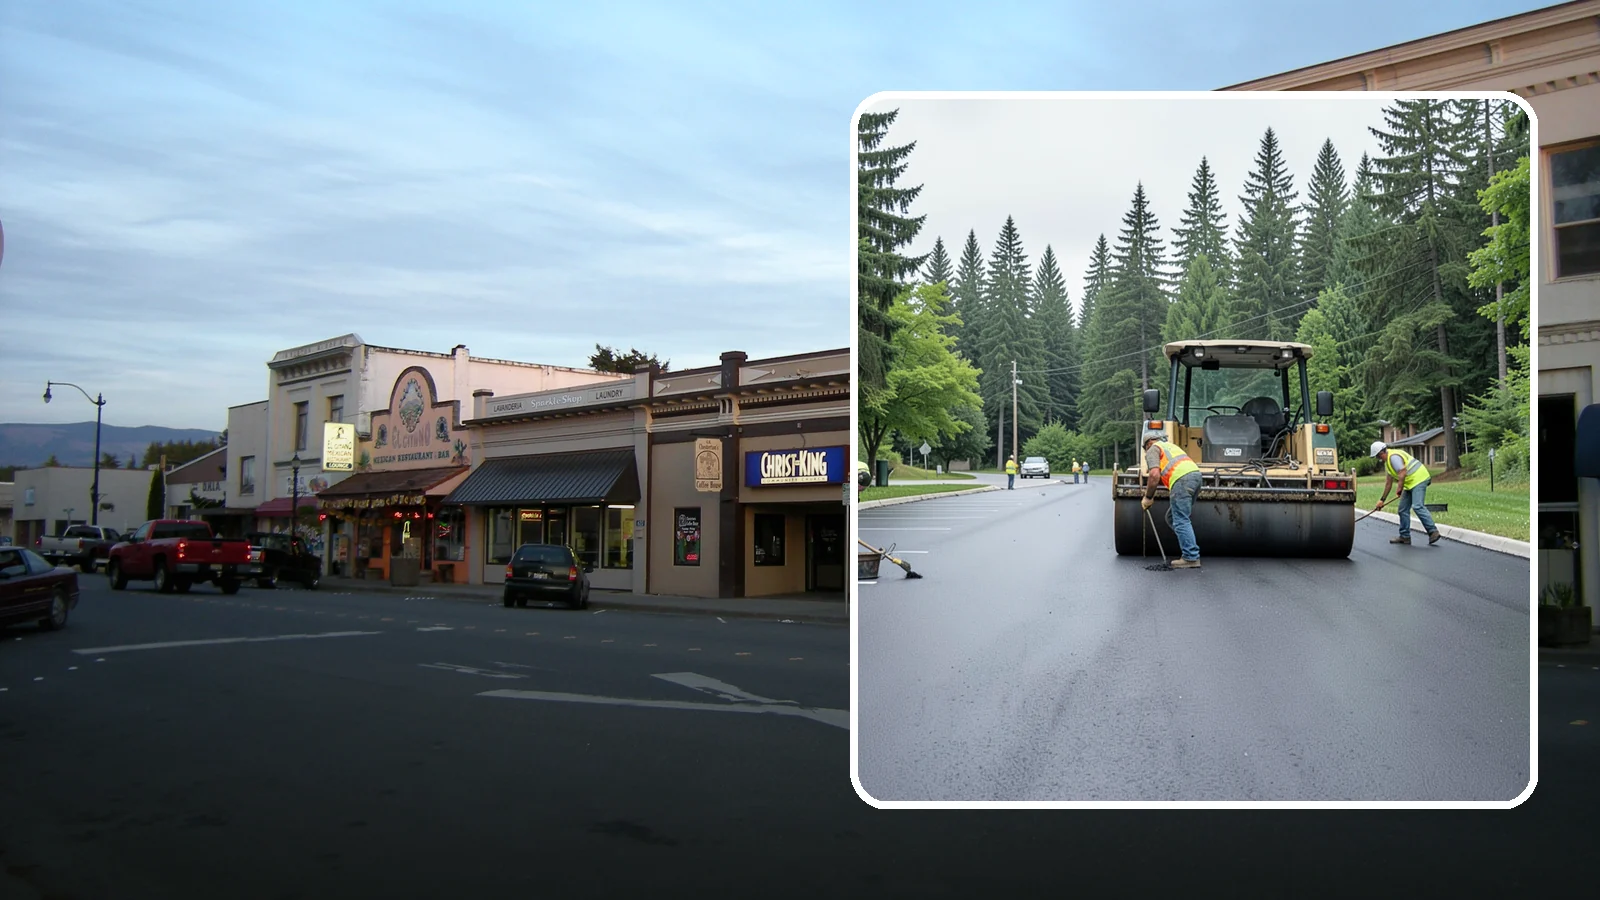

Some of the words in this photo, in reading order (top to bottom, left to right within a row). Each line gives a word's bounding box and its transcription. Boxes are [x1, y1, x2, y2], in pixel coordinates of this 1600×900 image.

[562, 394, 582, 404] Shop
[595, 389, 623, 400] LAUNDRY
[493, 401, 523, 412] LAVANDERIA
[397, 451, 433, 462] RESTAURANT
[438, 450, 450, 459] BAR
[761, 451, 798, 478] CHRIST
[799, 449, 827, 476] KING
